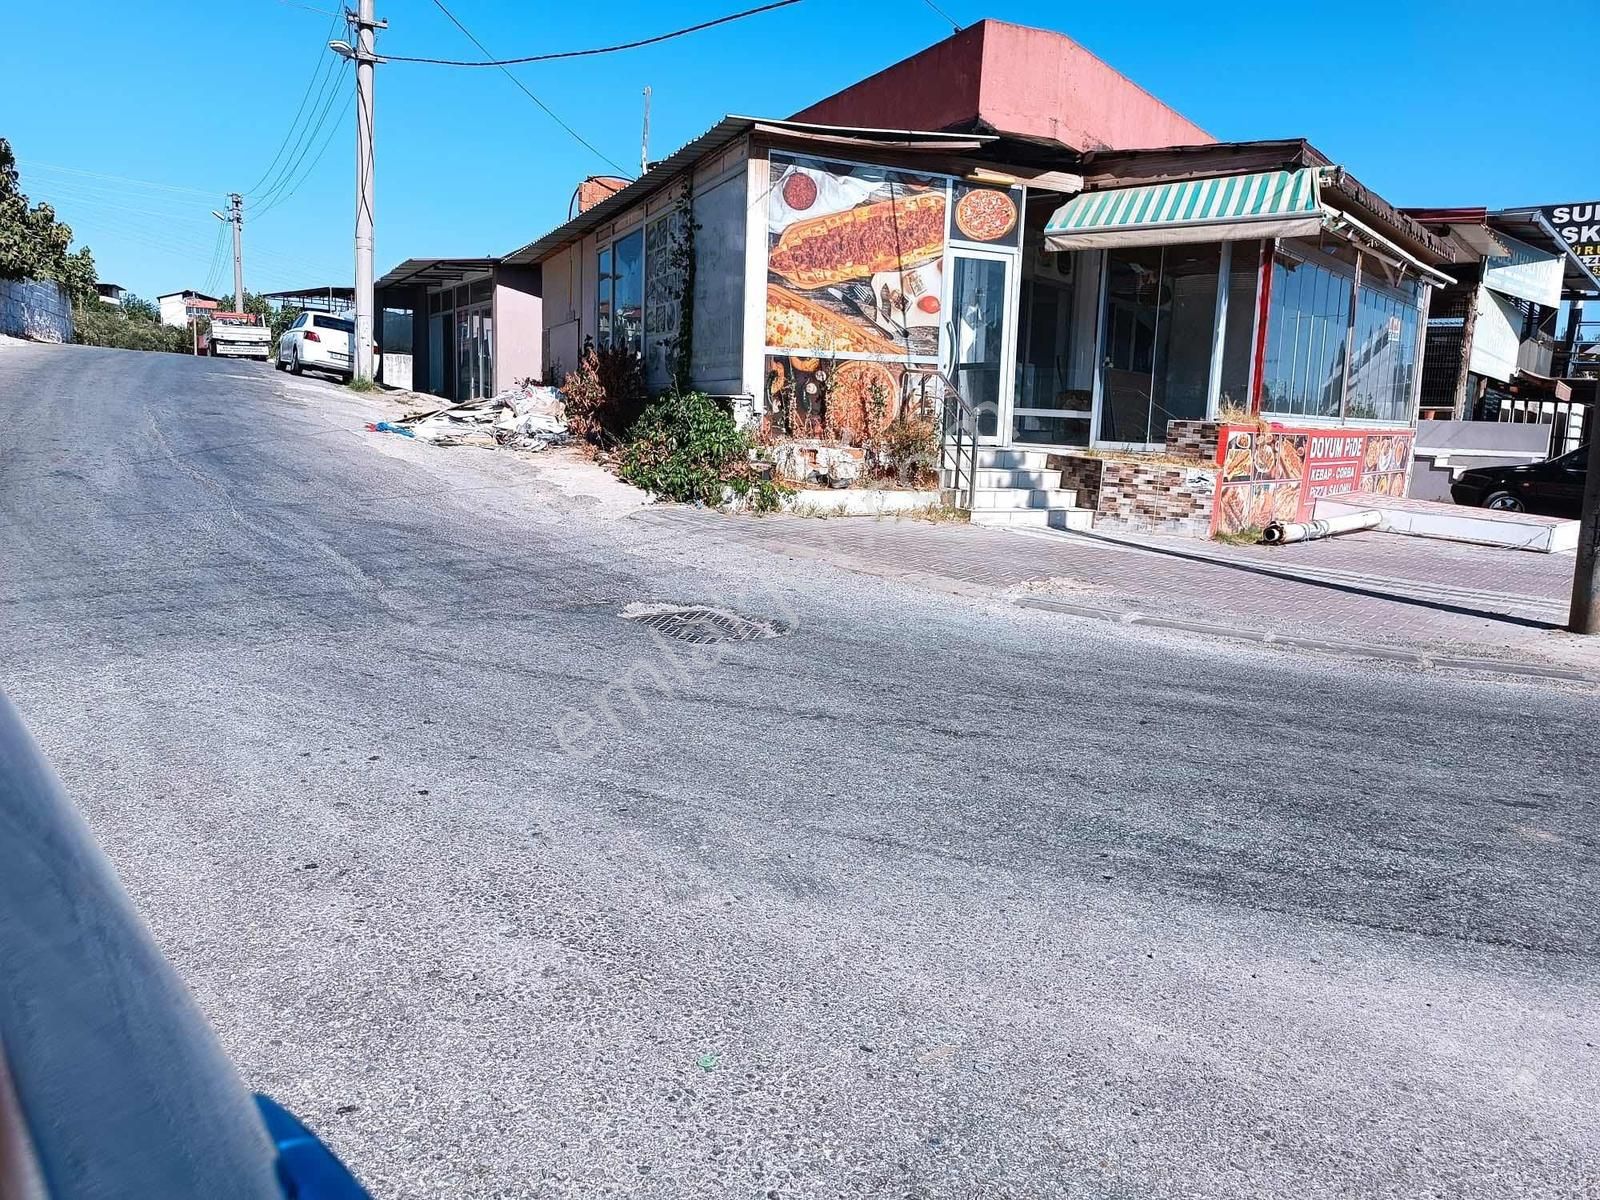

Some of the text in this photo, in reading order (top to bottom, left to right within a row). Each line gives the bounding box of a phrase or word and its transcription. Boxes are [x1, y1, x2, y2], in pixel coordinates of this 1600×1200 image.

[1556, 224, 1600, 245] SK
[1310, 437, 1343, 458] DOYUM
[1310, 468, 1332, 481] KEBAP
